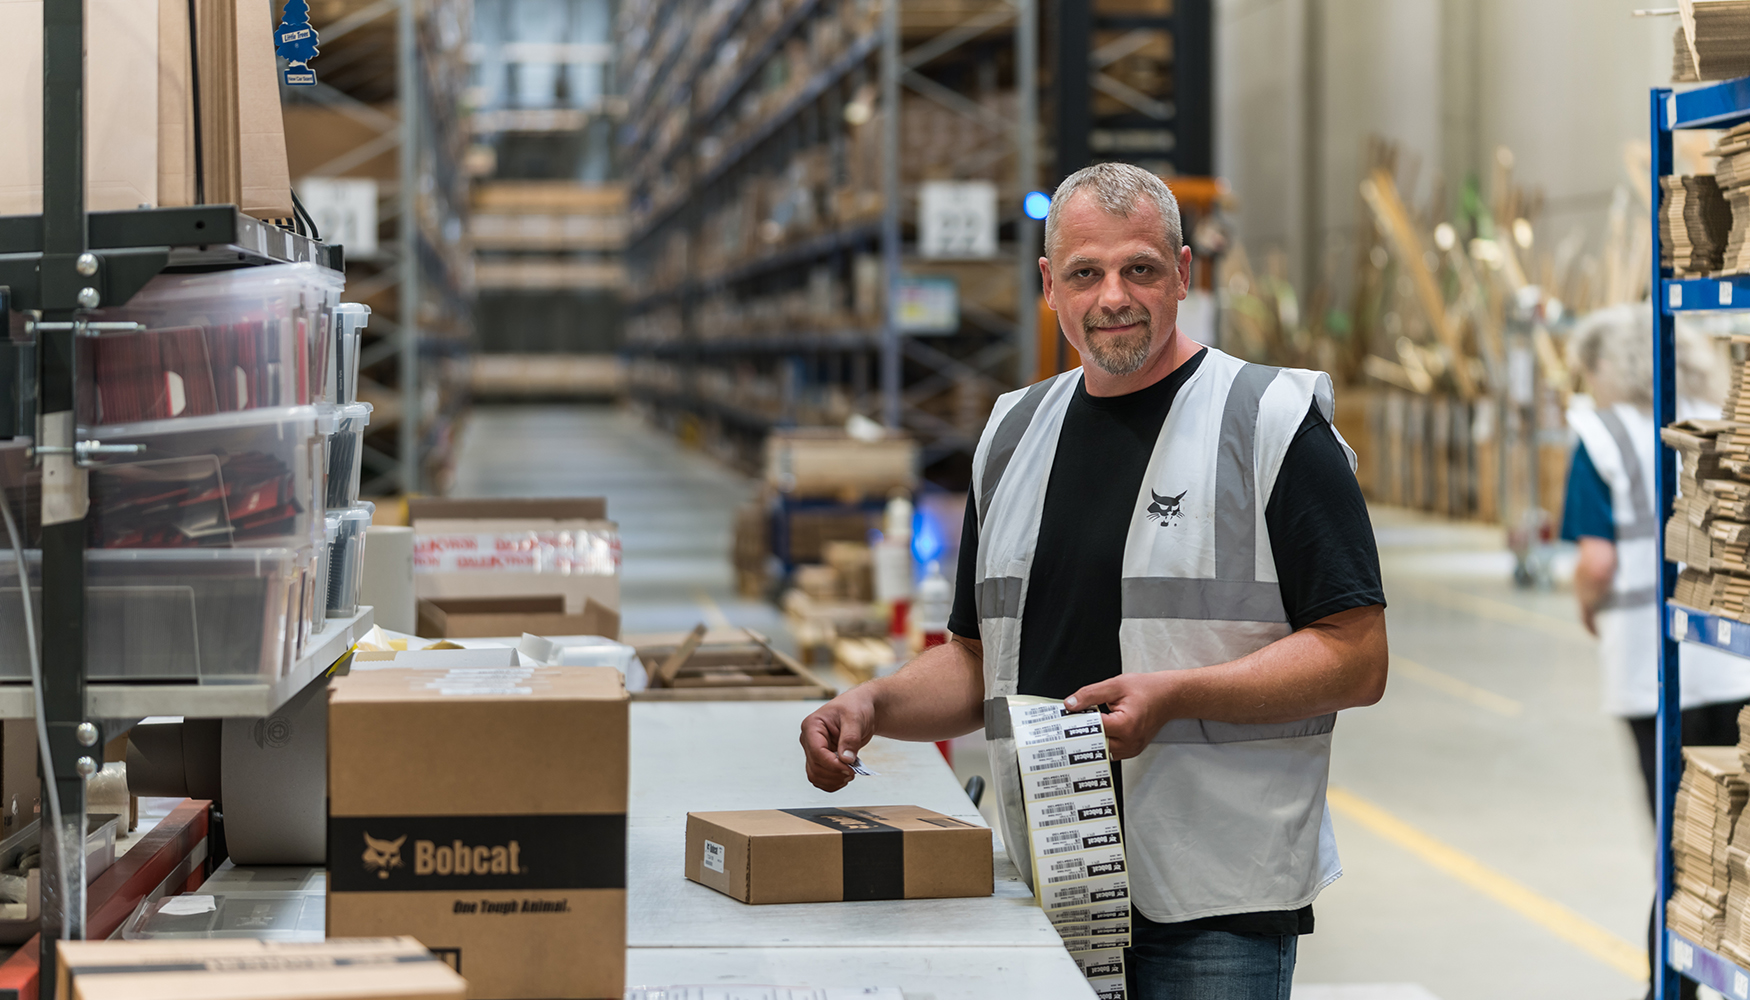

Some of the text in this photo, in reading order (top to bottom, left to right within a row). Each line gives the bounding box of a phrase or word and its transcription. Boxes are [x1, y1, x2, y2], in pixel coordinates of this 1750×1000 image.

[1074, 752, 1094, 761] Bobcat
[1078, 780, 1098, 789] Bobcat
[1083, 808, 1103, 817] Bobcat
[1088, 836, 1108, 845] Bobcat
[414, 840, 521, 876] Bobcat
[453, 899, 572, 915] One Tough Animal.
